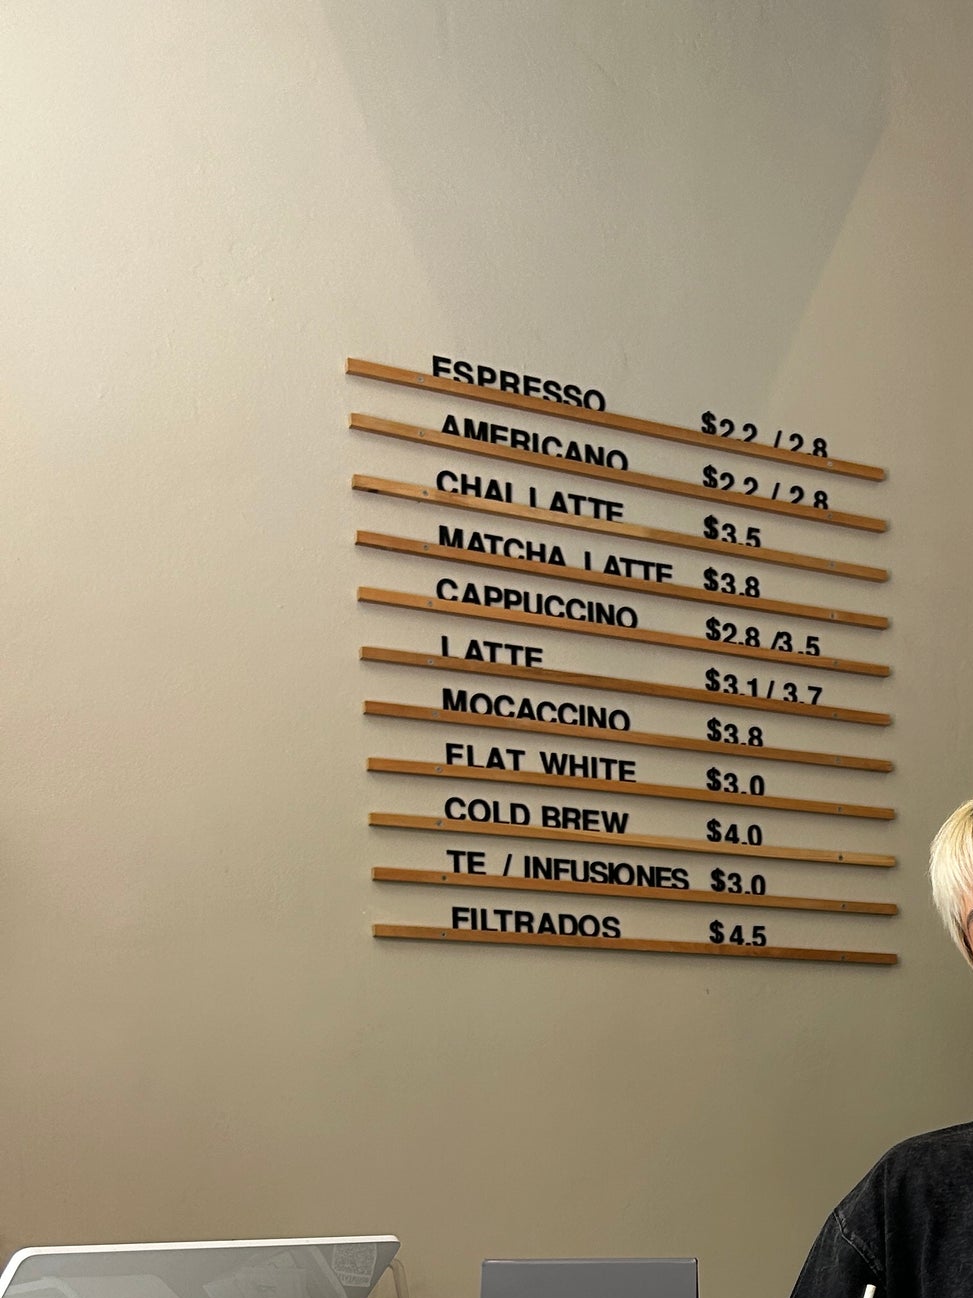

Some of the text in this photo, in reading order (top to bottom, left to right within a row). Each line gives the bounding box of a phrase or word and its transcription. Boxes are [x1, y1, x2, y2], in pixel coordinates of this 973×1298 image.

[432, 355, 606, 412] ESPRESSO
[441, 414, 629, 471] AMERICANO
[436, 470, 512, 504] CHAI
[438, 525, 566, 567] MATCHA
[703, 567, 760, 599] $3.8
[436, 578, 638, 629] CAPPUCCINO
[705, 617, 761, 648] $2.8
[441, 635, 543, 668] LATTE
[442, 688, 763, 747] MOCACCINO $3.8
[445, 743, 765, 796] FLAT WHITE $3.0
[444, 797, 762, 846] COLD BREW $4.0
[446, 850, 487, 875] TE
[524, 855, 690, 889] INFUSIONES
[710, 867, 766, 896] $3.0
[452, 906, 767, 946] FILTRADOS $4.5
